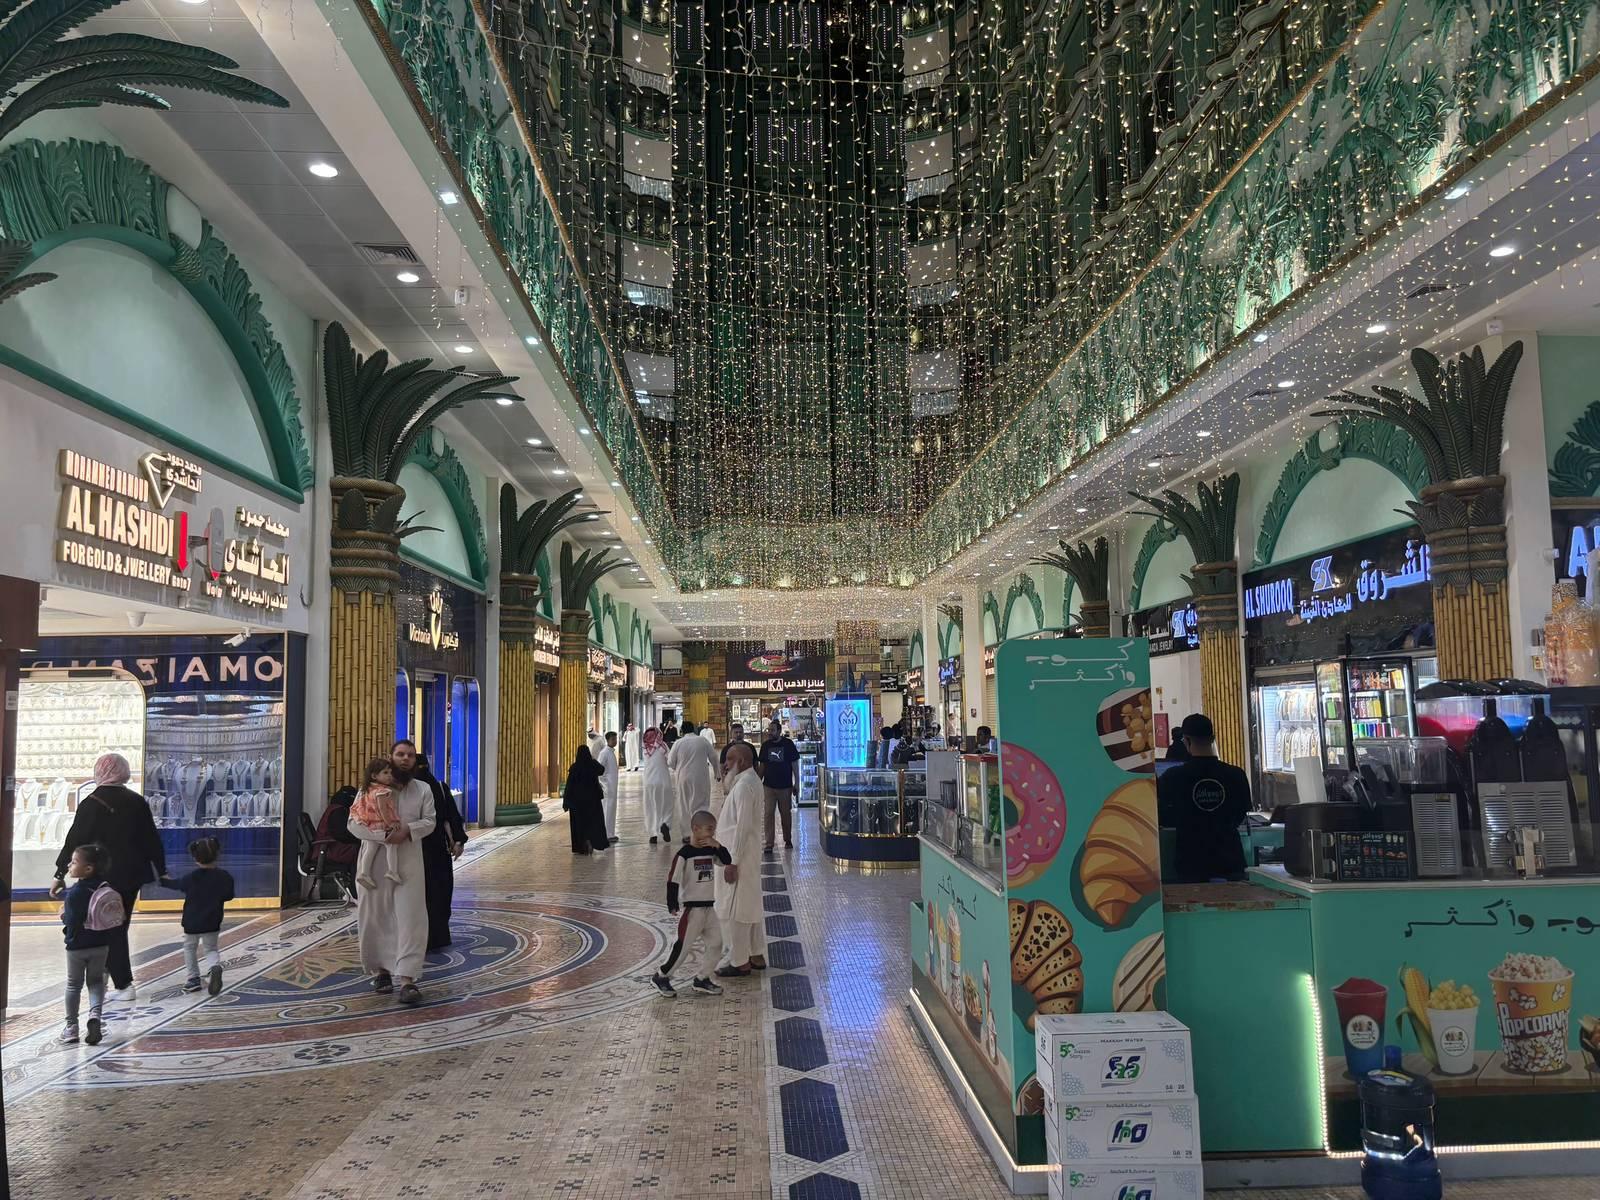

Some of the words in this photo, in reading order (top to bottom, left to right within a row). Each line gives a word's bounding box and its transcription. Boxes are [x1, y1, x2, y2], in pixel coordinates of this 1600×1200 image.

[66, 449, 116, 491] MOHAMMED
[66, 485, 96, 536] AL
[98, 494, 174, 557] HASHIDI
[123, 556, 172, 586] JWELLERY
[1357, 540, 1431, 603] الشروق
[1245, 589, 1255, 620] AL
[1256, 578, 1294, 616] SHUROOQ
